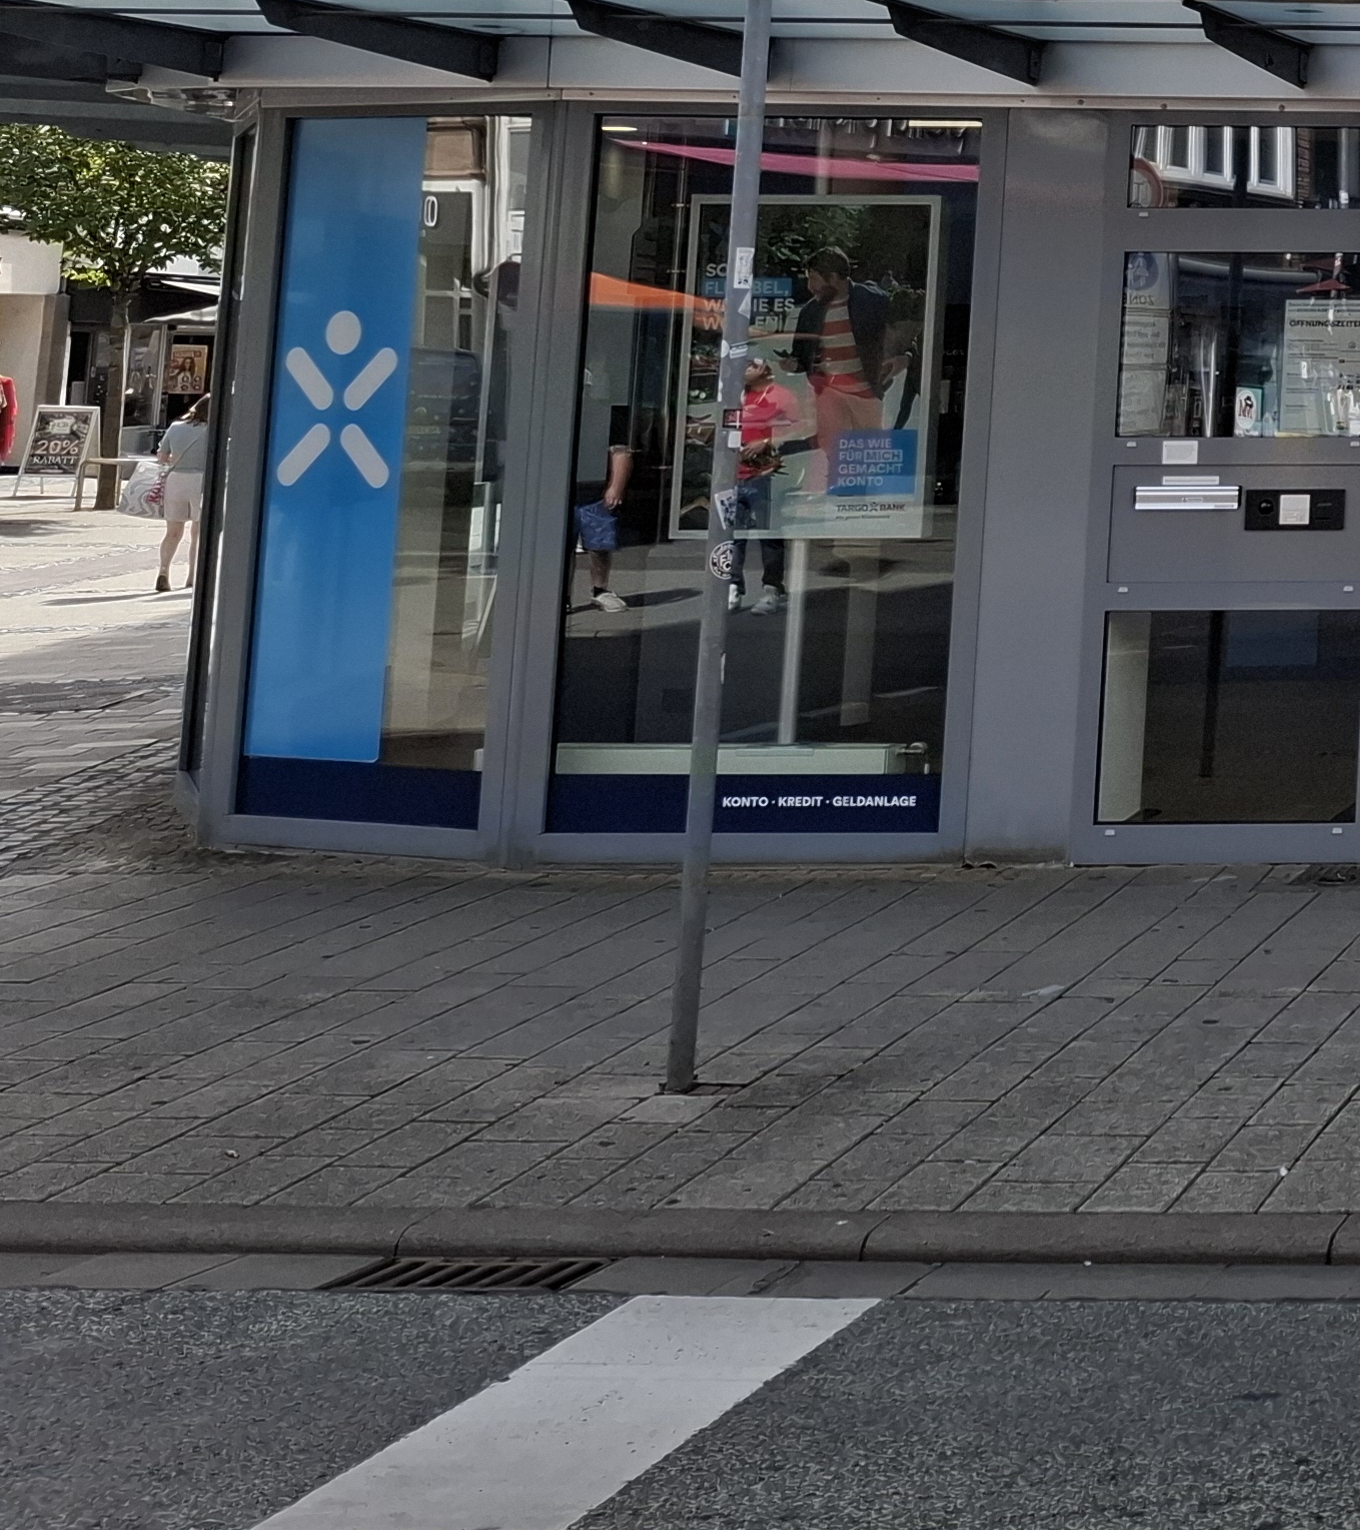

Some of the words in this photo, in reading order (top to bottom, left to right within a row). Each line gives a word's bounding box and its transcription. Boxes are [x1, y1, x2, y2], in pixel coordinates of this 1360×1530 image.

[36, 439, 80, 455] 20%
[839, 438, 864, 449] DAS
[867, 438, 892, 448] WIE
[31, 454, 79, 465] RABATT
[837, 476, 884, 487] KONTO
[722, 796, 769, 808] KONTO
[778, 795, 824, 807] KREDIT
[832, 795, 917, 807] GELDANLAGE
